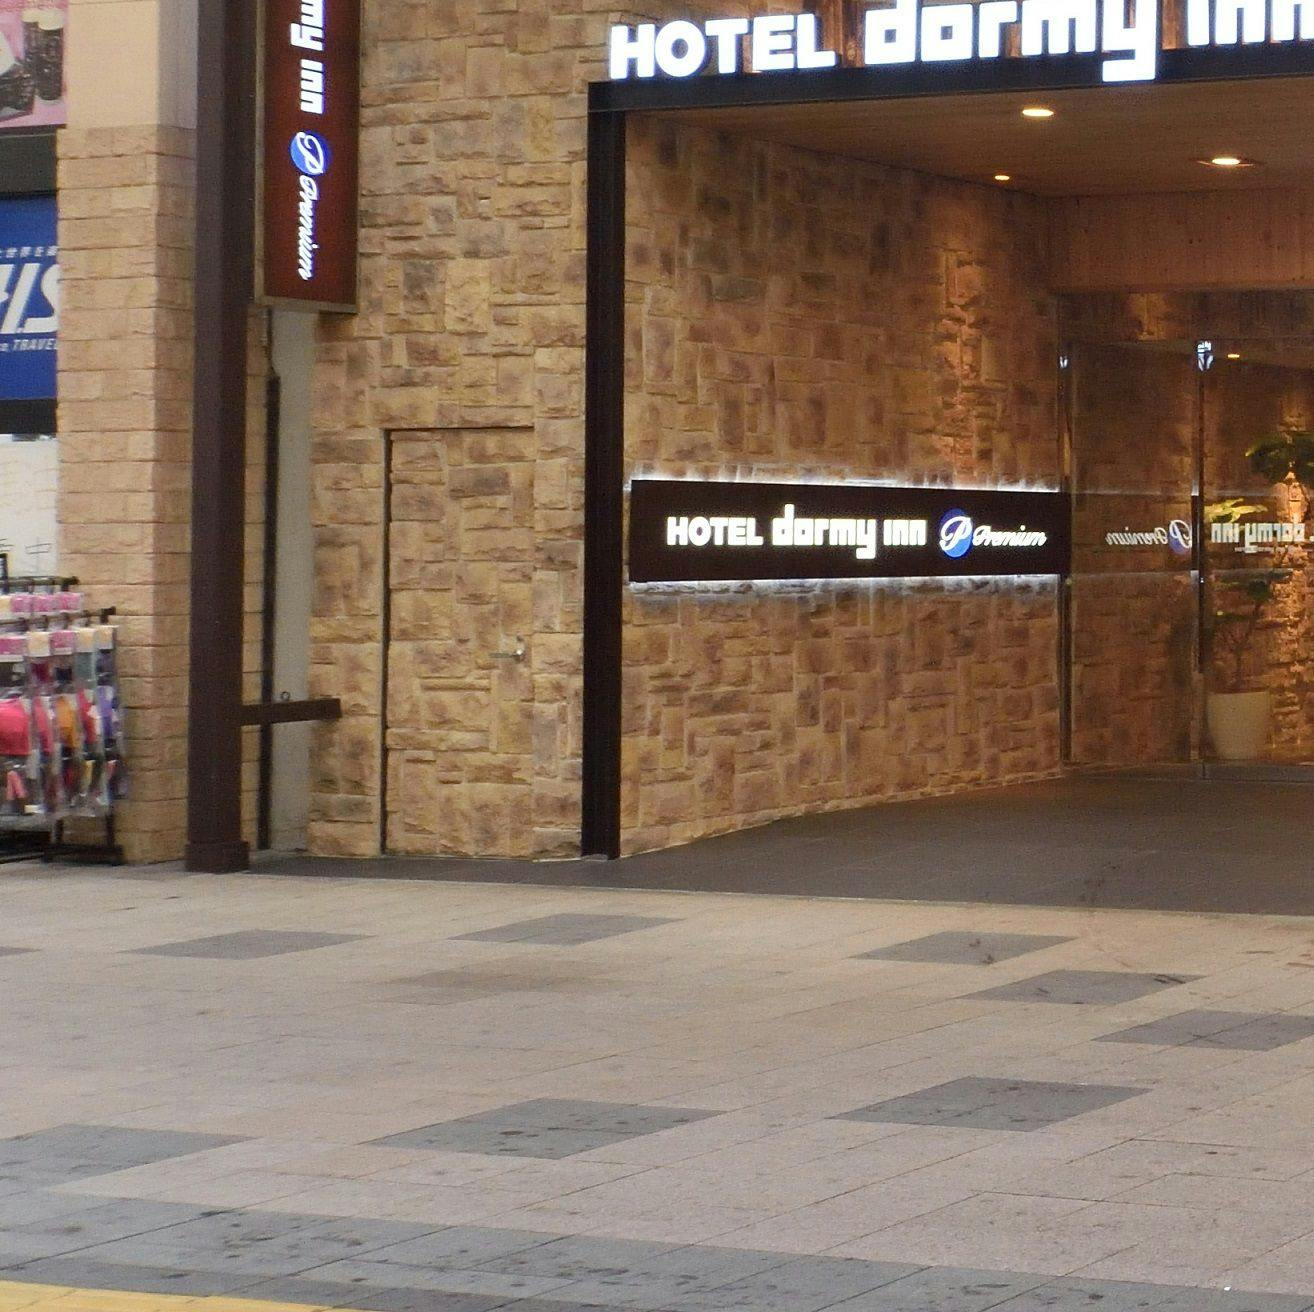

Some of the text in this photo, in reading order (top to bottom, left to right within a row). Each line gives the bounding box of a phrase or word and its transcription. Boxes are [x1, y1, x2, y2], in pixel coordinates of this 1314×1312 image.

[610, 14, 837, 81] HOTEL
[300, 58, 324, 115] inn
[298, 175, 319, 281] Premium
[667, 516, 764, 546] HOTEL
[772, 503, 876, 559] dormy
[883, 519, 927, 546] inn
[972, 525, 1047, 546] Premium
